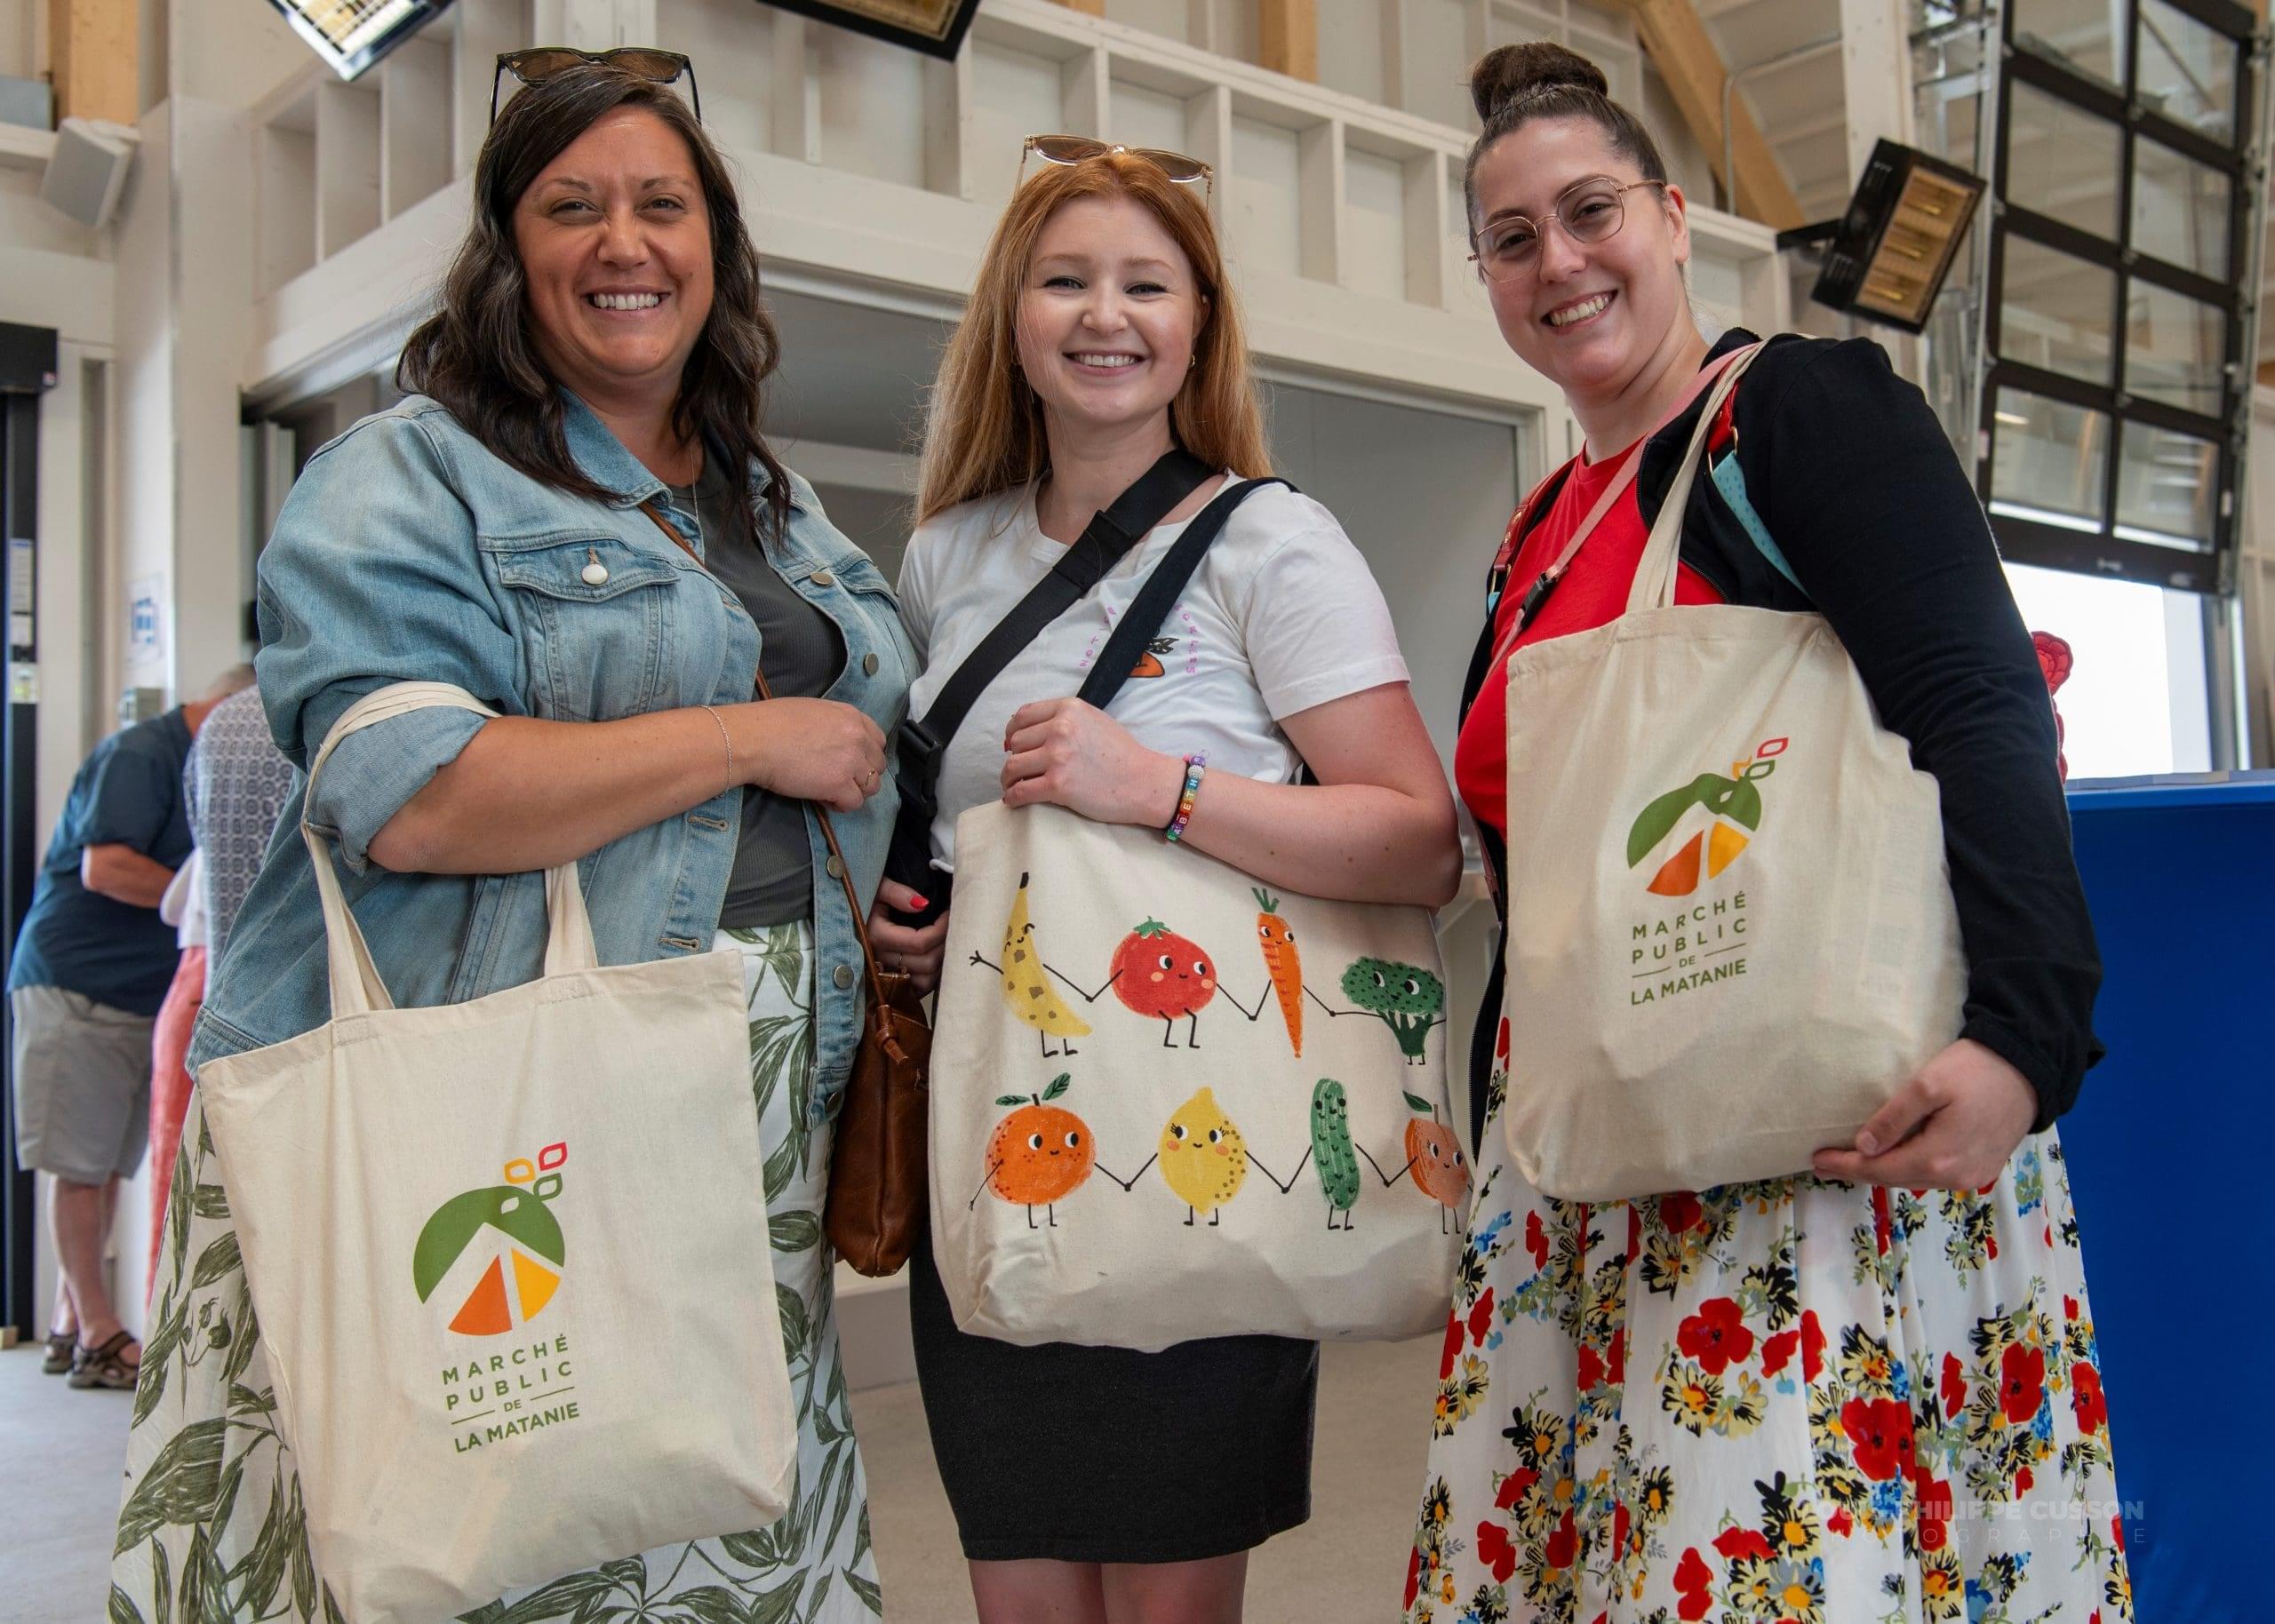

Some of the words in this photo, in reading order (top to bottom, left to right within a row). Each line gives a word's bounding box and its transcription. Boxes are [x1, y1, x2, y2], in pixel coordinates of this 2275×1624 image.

[1632, 890, 1746, 940] MARCHÉ
[1632, 918, 1746, 964] PUBLIC
[1679, 955, 1696, 967] DE
[1631, 988, 1655, 1006] LA
[1661, 959, 1746, 998] MATANIE
[442, 1333, 569, 1385] MARCHÉ
[446, 1361, 572, 1411] PUBLIC
[504, 1399, 523, 1412] DE
[454, 1432, 483, 1453] LA
[486, 1402, 580, 1443] MATANIE
